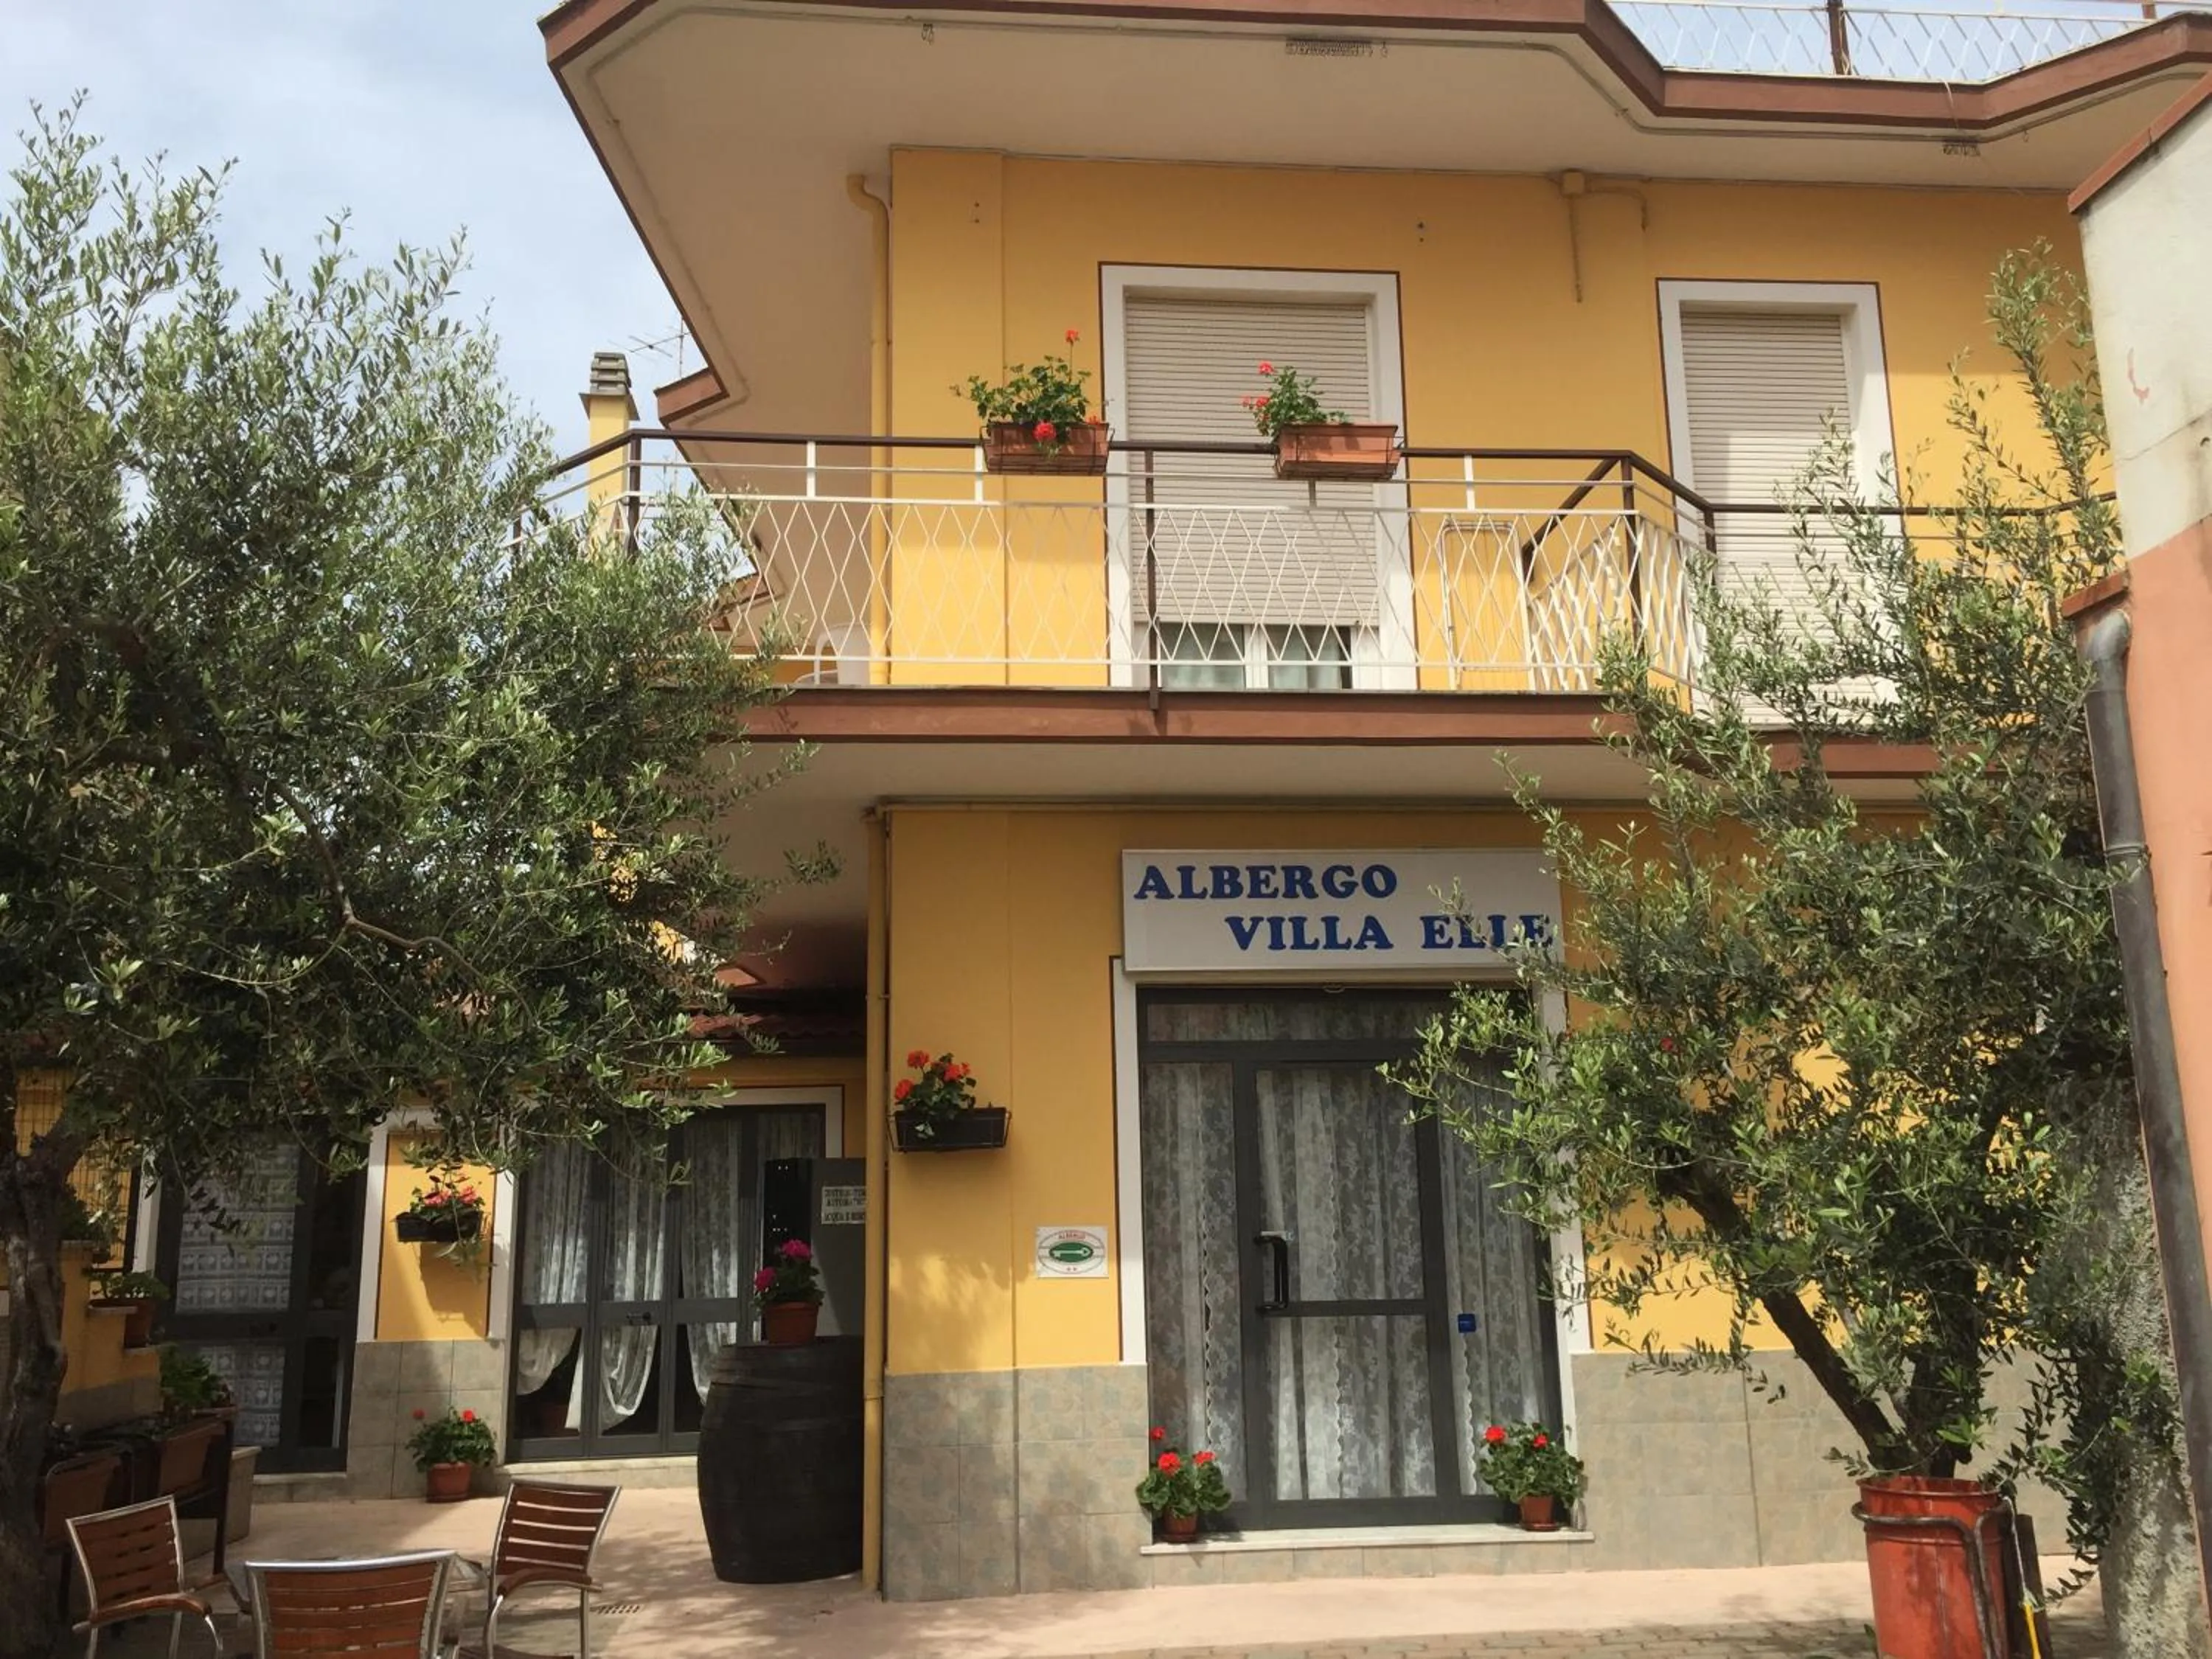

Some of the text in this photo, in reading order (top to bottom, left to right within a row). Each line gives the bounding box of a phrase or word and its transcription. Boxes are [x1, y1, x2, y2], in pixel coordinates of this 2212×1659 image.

[1134, 864, 1397, 900] ALBERGO
[1225, 914, 1554, 951] VILLA ELIE
